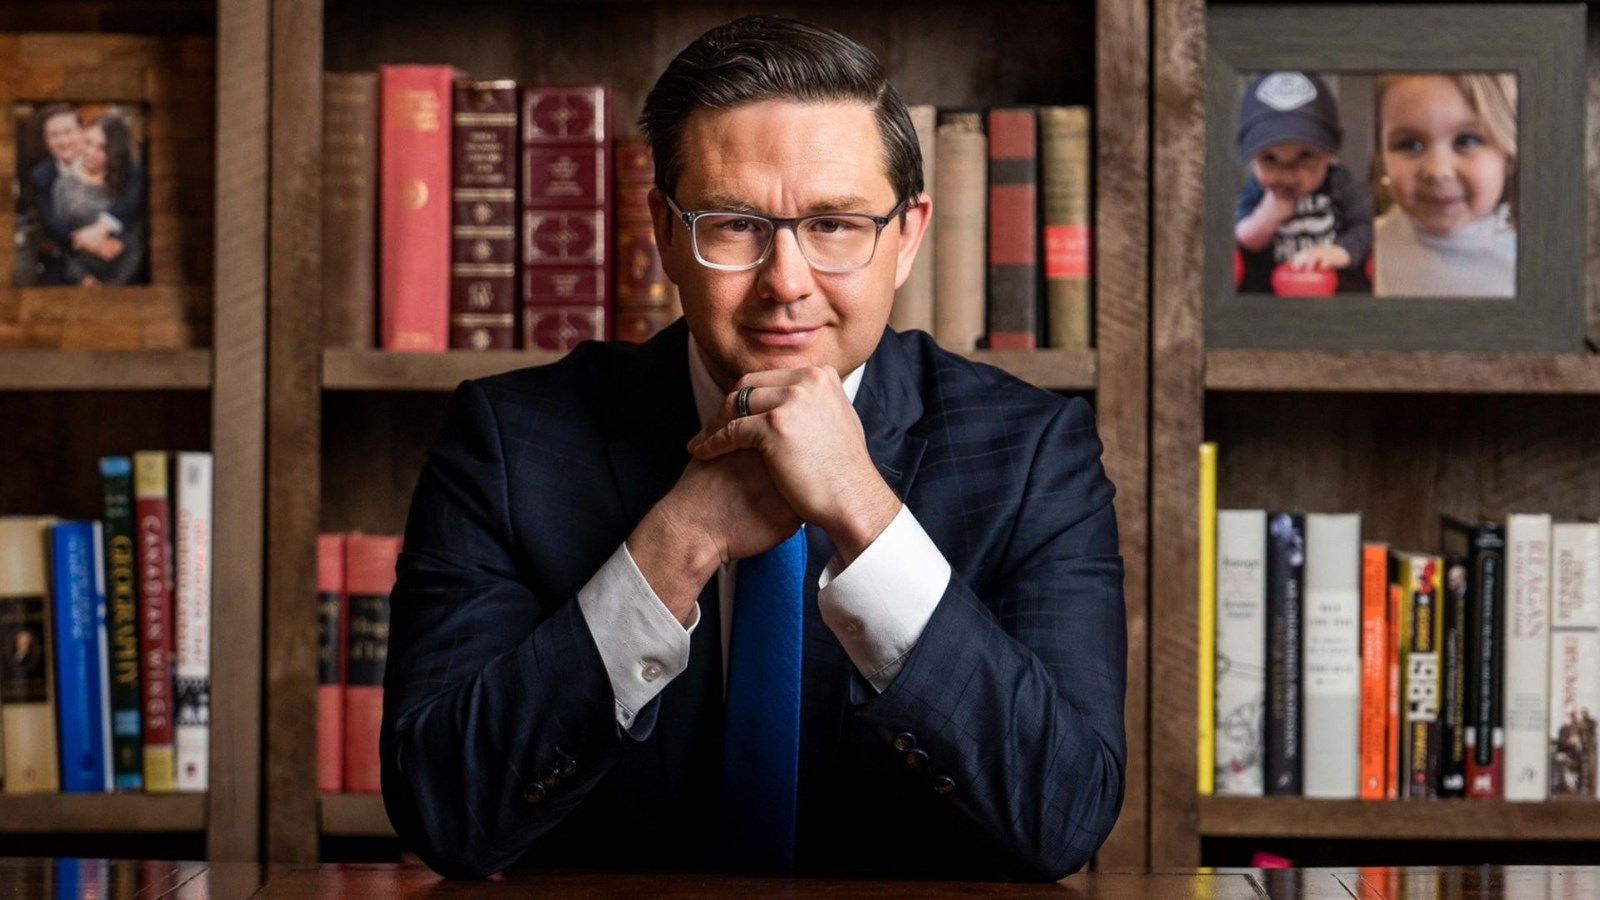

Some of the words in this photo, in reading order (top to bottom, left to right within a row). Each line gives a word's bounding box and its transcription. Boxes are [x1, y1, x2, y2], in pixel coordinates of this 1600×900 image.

[142, 515, 163, 640] CANADIAN
[147, 648, 166, 729] WINGS
[1407, 652, 1439, 722] 1984
